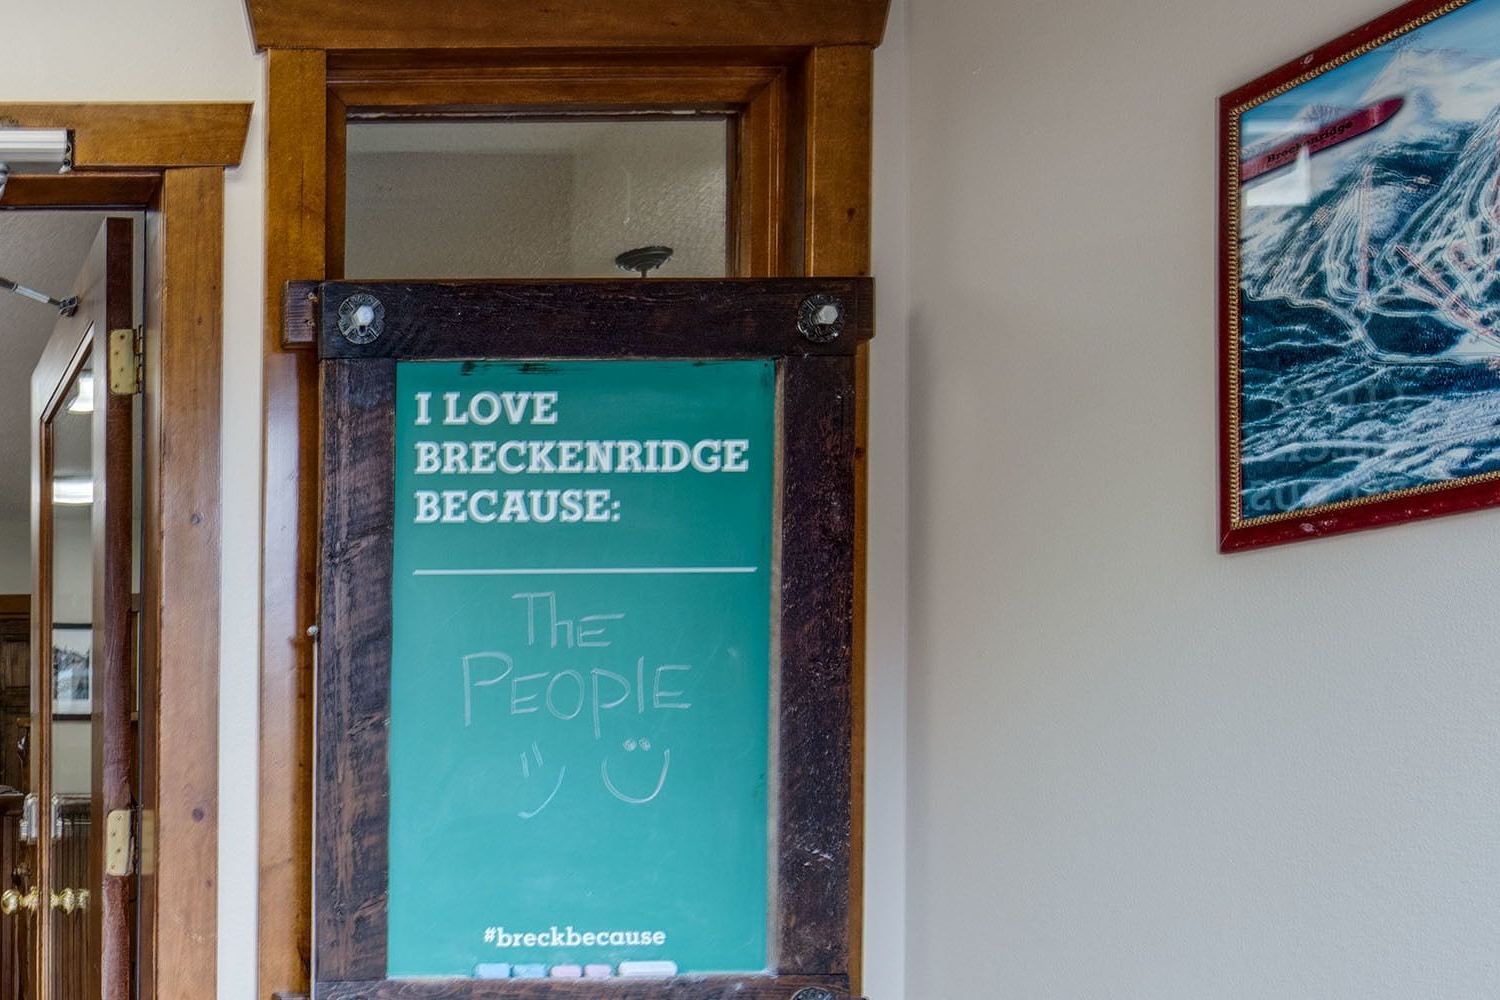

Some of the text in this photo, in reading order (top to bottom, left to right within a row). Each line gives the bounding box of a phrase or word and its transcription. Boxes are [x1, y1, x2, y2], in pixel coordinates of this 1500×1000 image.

[413, 391, 558, 425] I LOVE
[413, 439, 749, 474] BRECKENRIDGE
[413, 489, 621, 524] BECAUSE:
[483, 926, 667, 948] #breckbecause
